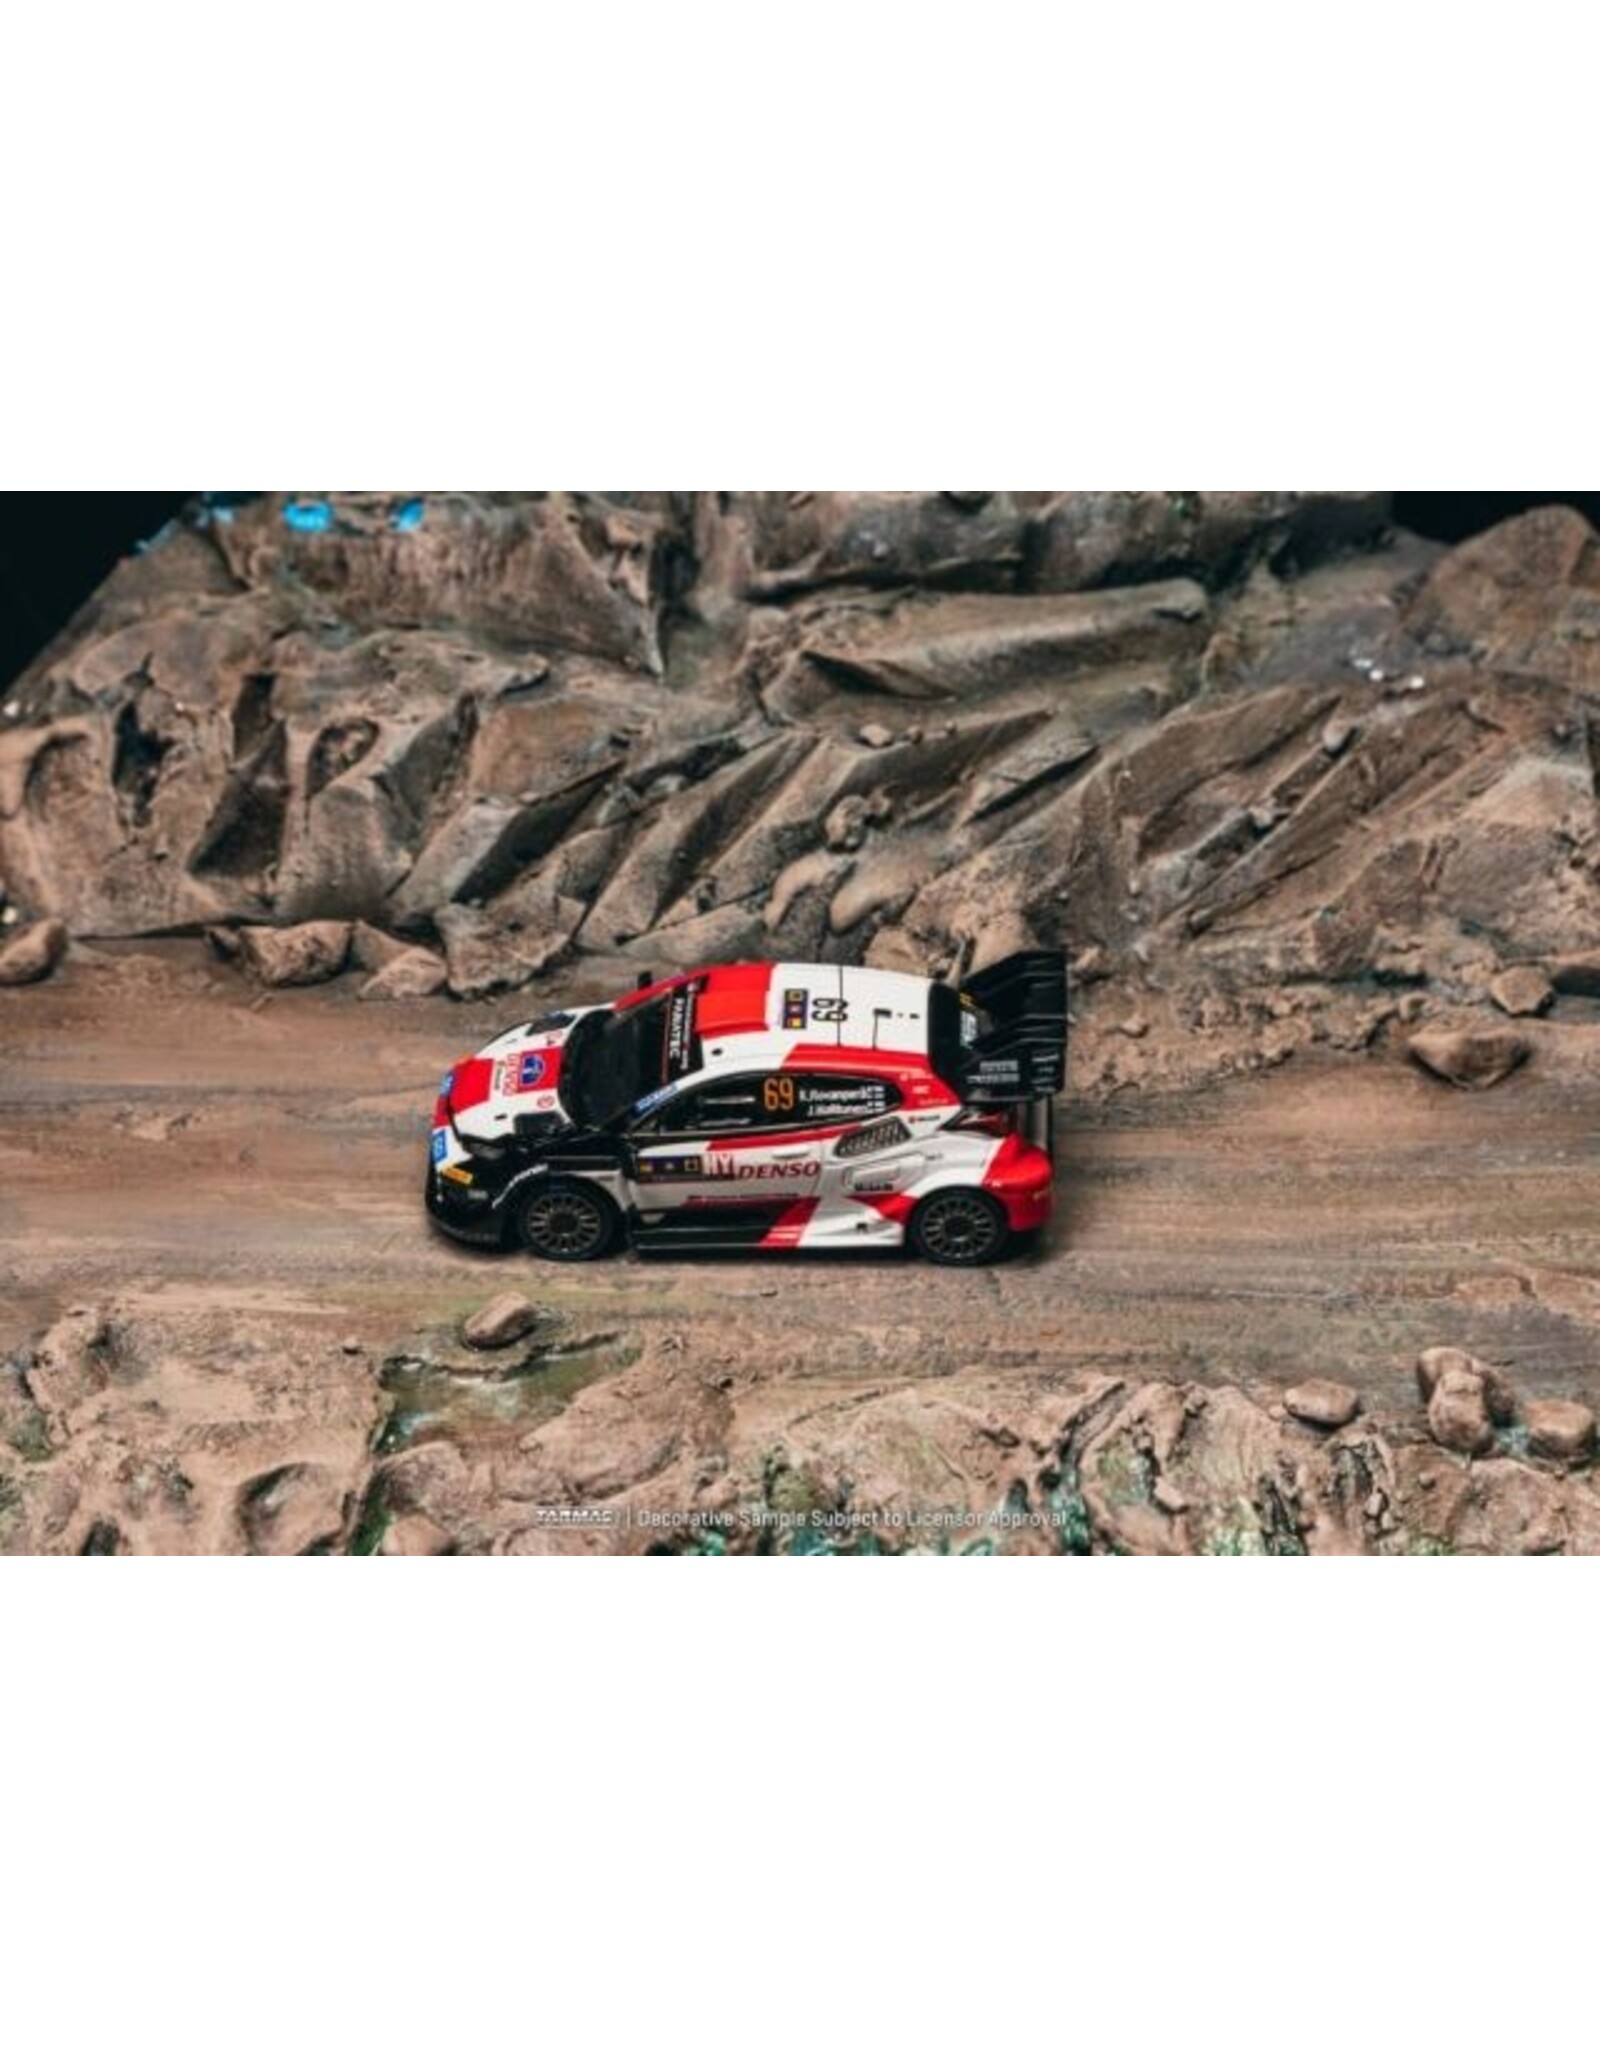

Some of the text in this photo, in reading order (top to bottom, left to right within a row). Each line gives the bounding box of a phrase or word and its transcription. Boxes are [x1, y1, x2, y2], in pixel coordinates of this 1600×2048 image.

[811, 998, 848, 1021] 69
[764, 1077, 794, 1111] 69
[738, 1160, 822, 1180] DENSO
